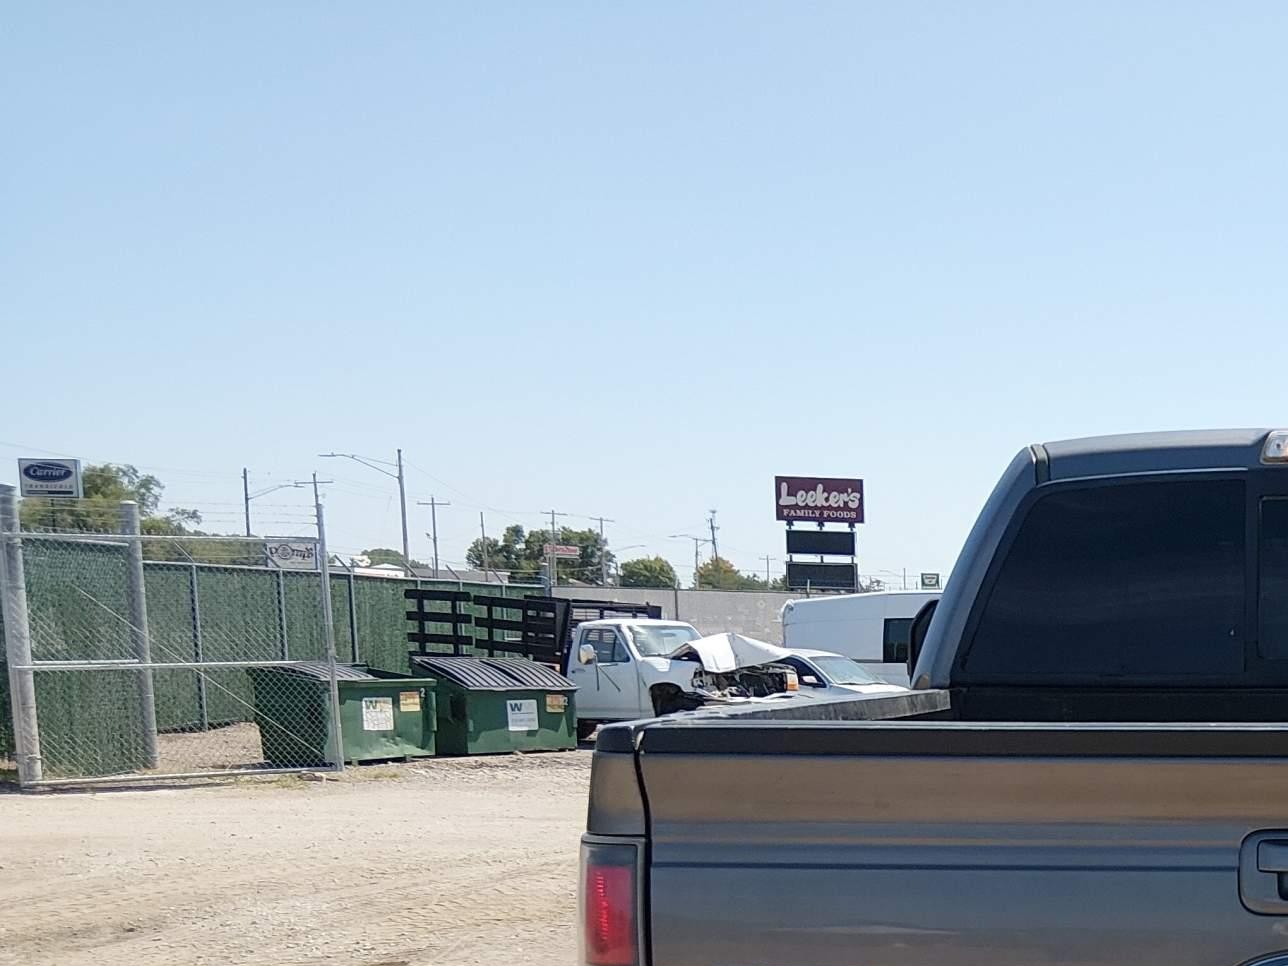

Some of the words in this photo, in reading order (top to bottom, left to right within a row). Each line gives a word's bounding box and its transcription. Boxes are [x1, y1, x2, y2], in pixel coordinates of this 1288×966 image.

[29, 466, 65, 476] Carrier
[778, 482, 861, 509] Leeker's
[783, 509, 821, 517] FAMILY
[823, 511, 857, 519] FOODS
